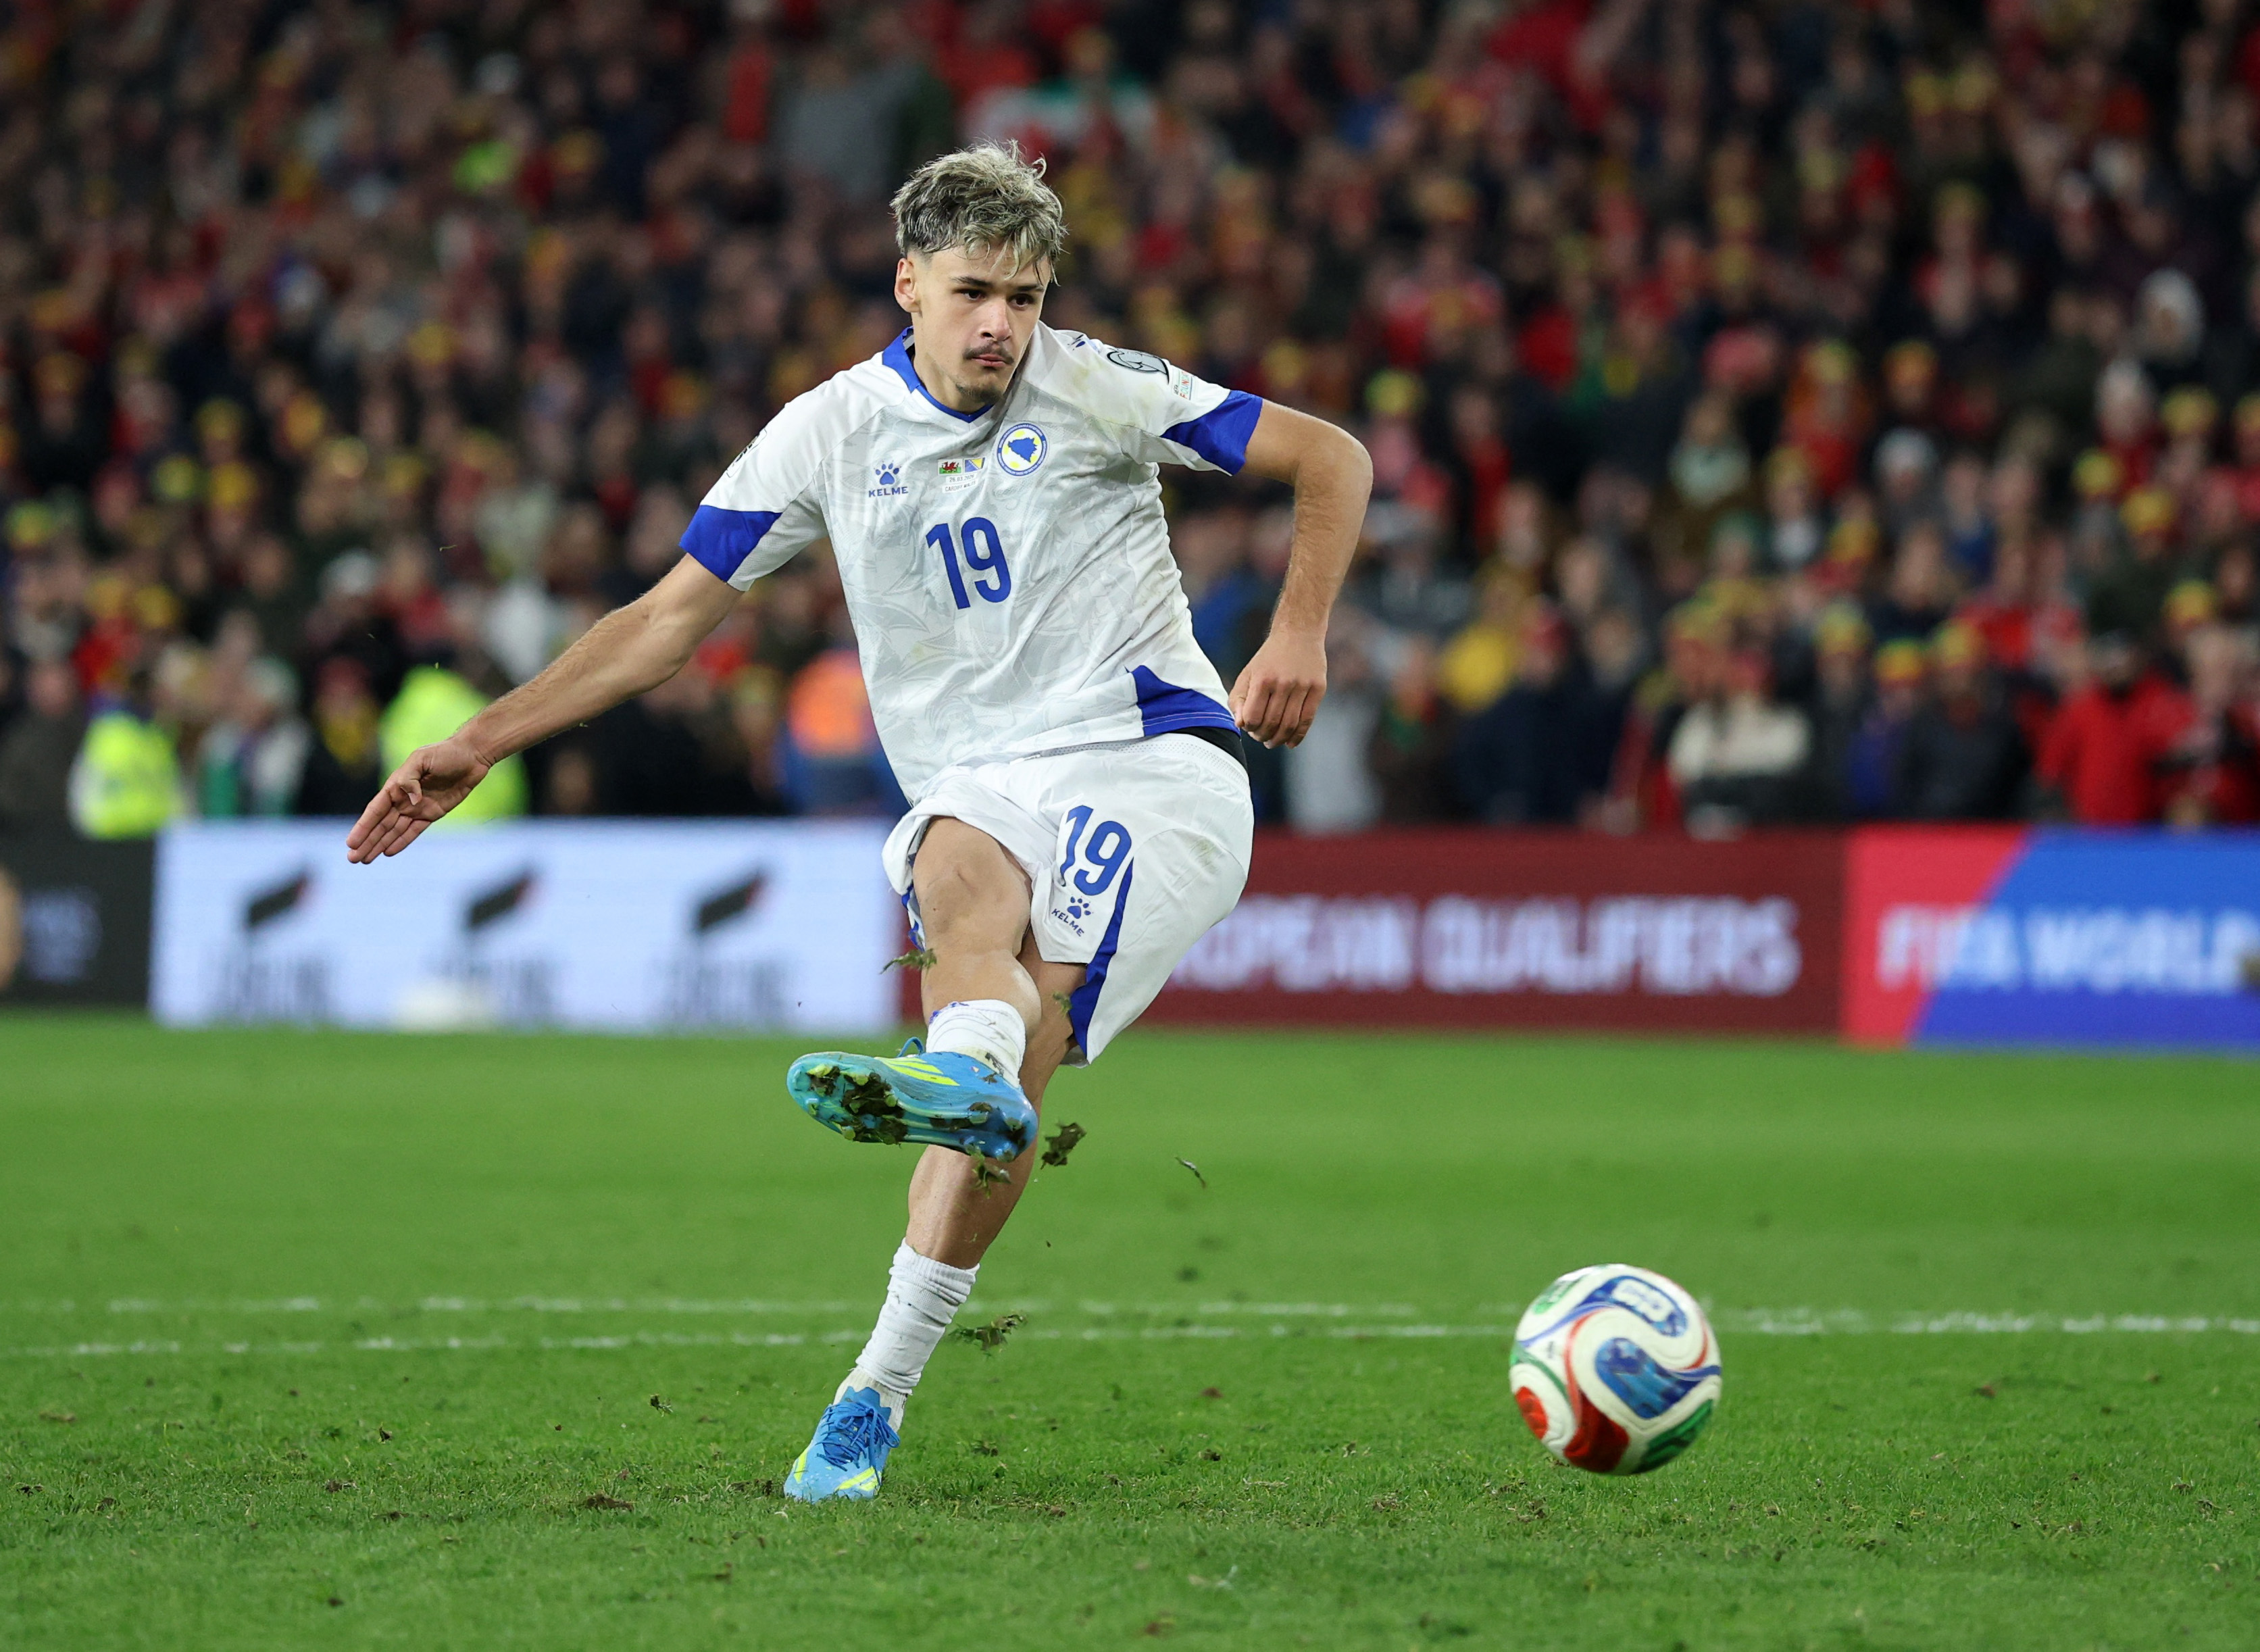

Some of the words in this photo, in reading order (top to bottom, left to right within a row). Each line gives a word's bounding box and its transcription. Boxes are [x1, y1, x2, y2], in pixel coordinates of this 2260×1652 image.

[869, 486, 909, 498] KELME
[926, 516, 1011, 609] 19
[1060, 805, 1132, 896] 19
[1051, 908, 1084, 937] KELME
[1422, 893, 1801, 996] QUALIFIERS
[1878, 902, 2022, 992] FIFA
